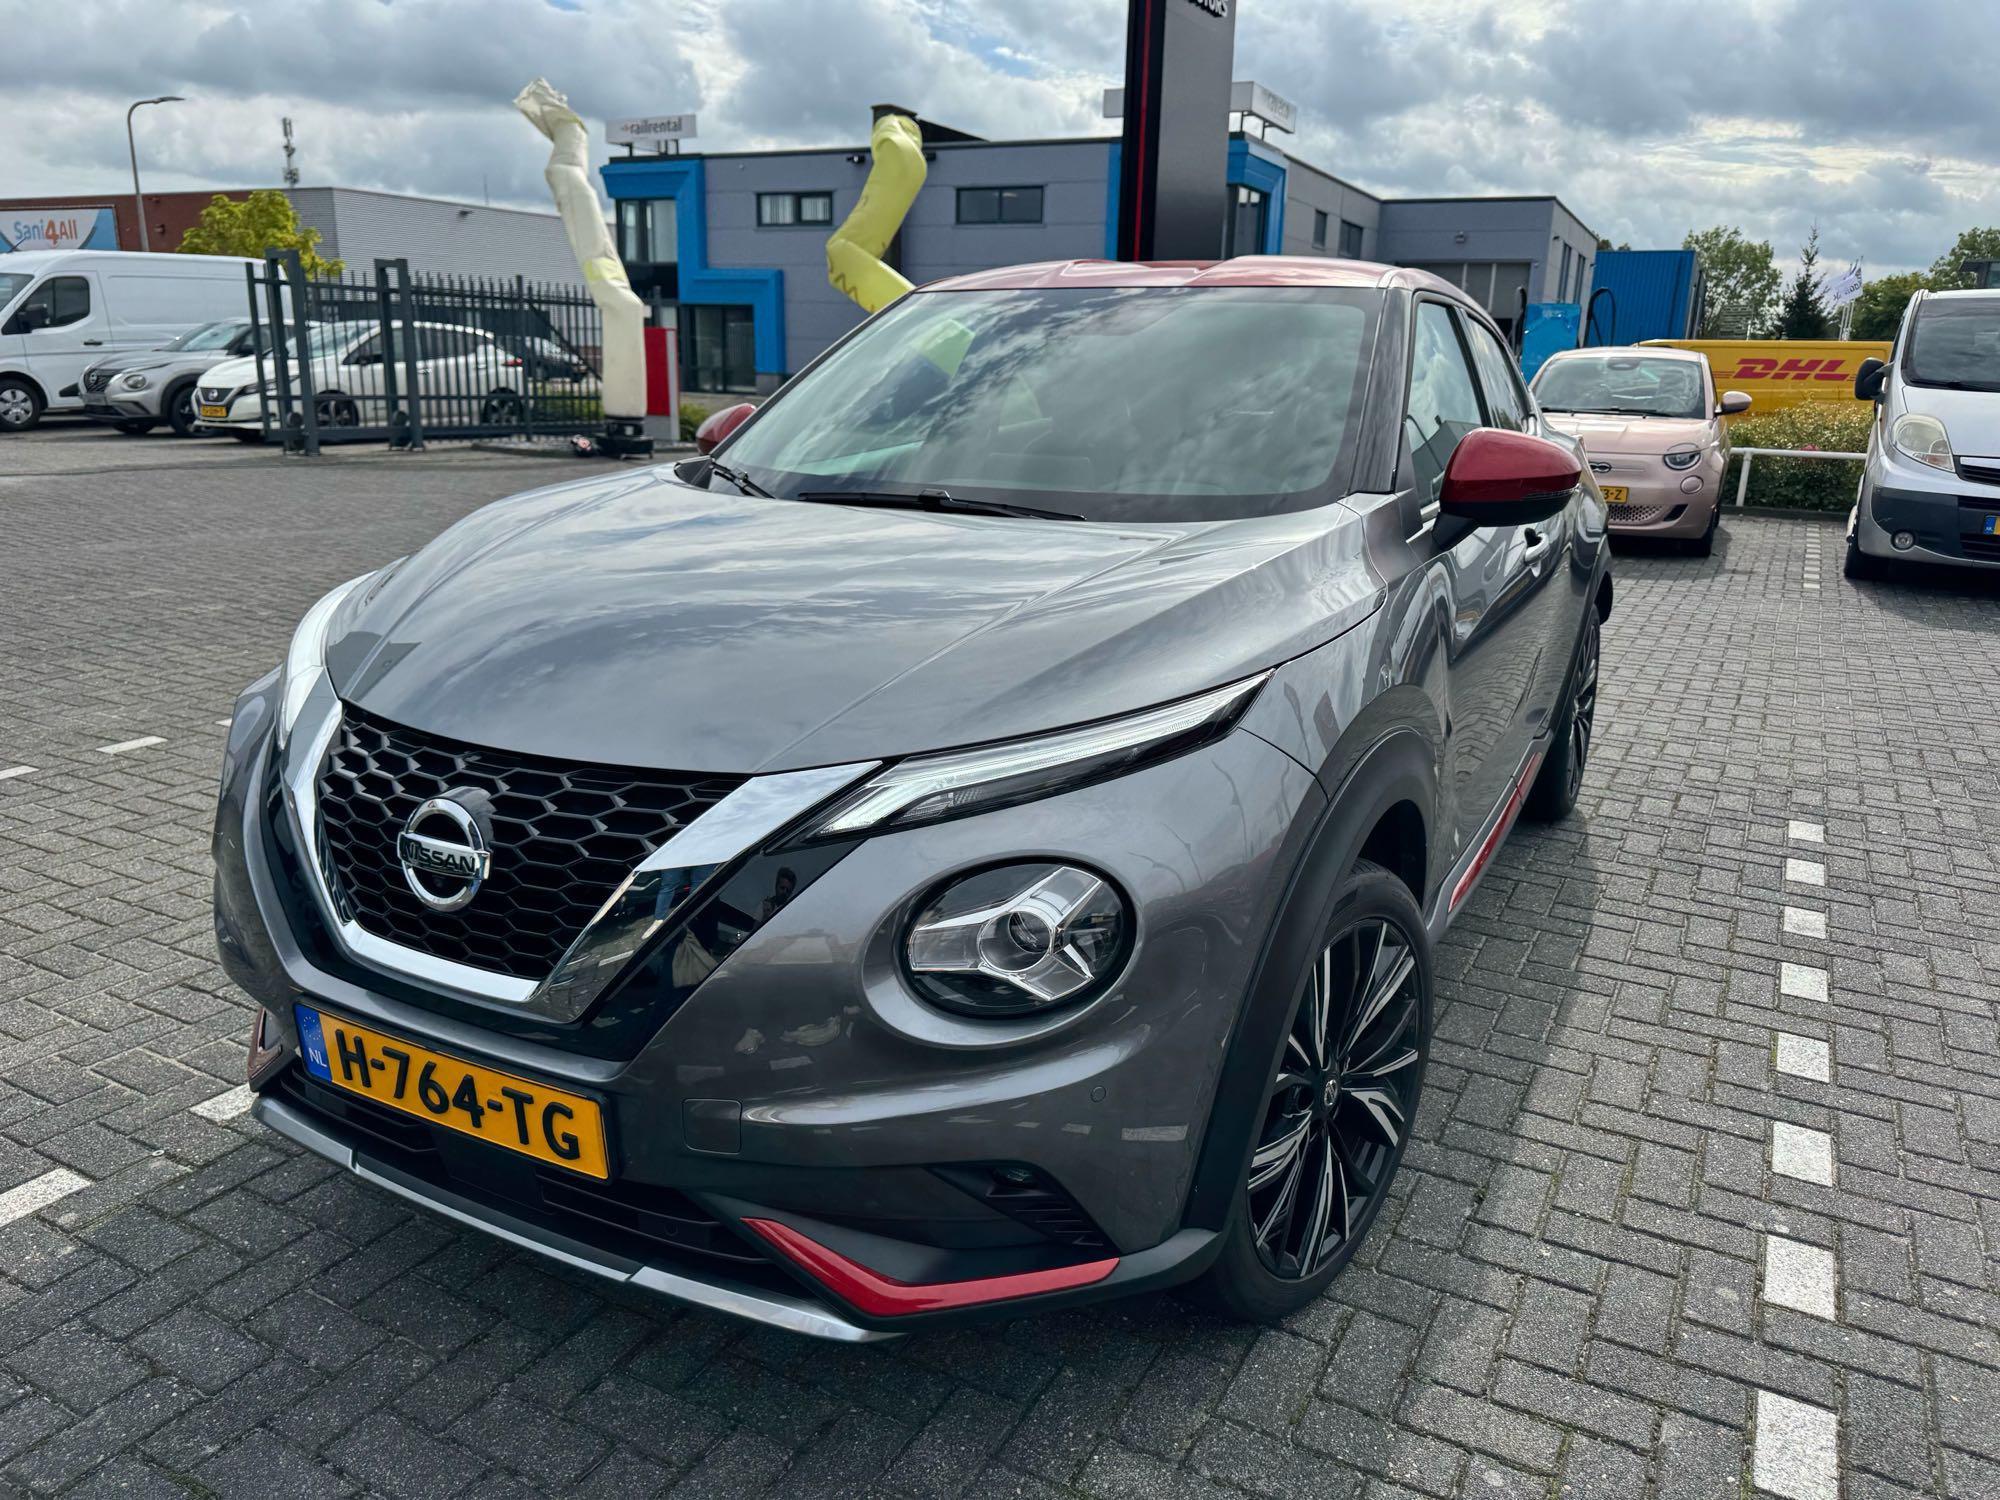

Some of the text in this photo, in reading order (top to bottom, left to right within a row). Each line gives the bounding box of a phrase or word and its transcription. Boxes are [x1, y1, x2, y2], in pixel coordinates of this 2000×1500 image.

[1197, 0, 1228, 17] ORS
[630, 116, 682, 135] railrental
[14, 219, 78, 246] Sani4All
[1732, 358, 1850, 381] DHL
[1600, 488, 1622, 500] 3-Z
[401, 838, 476, 876] NISSAN
[308, 1047, 327, 1068] NL
[335, 1029, 581, 1160] H-764-TG
